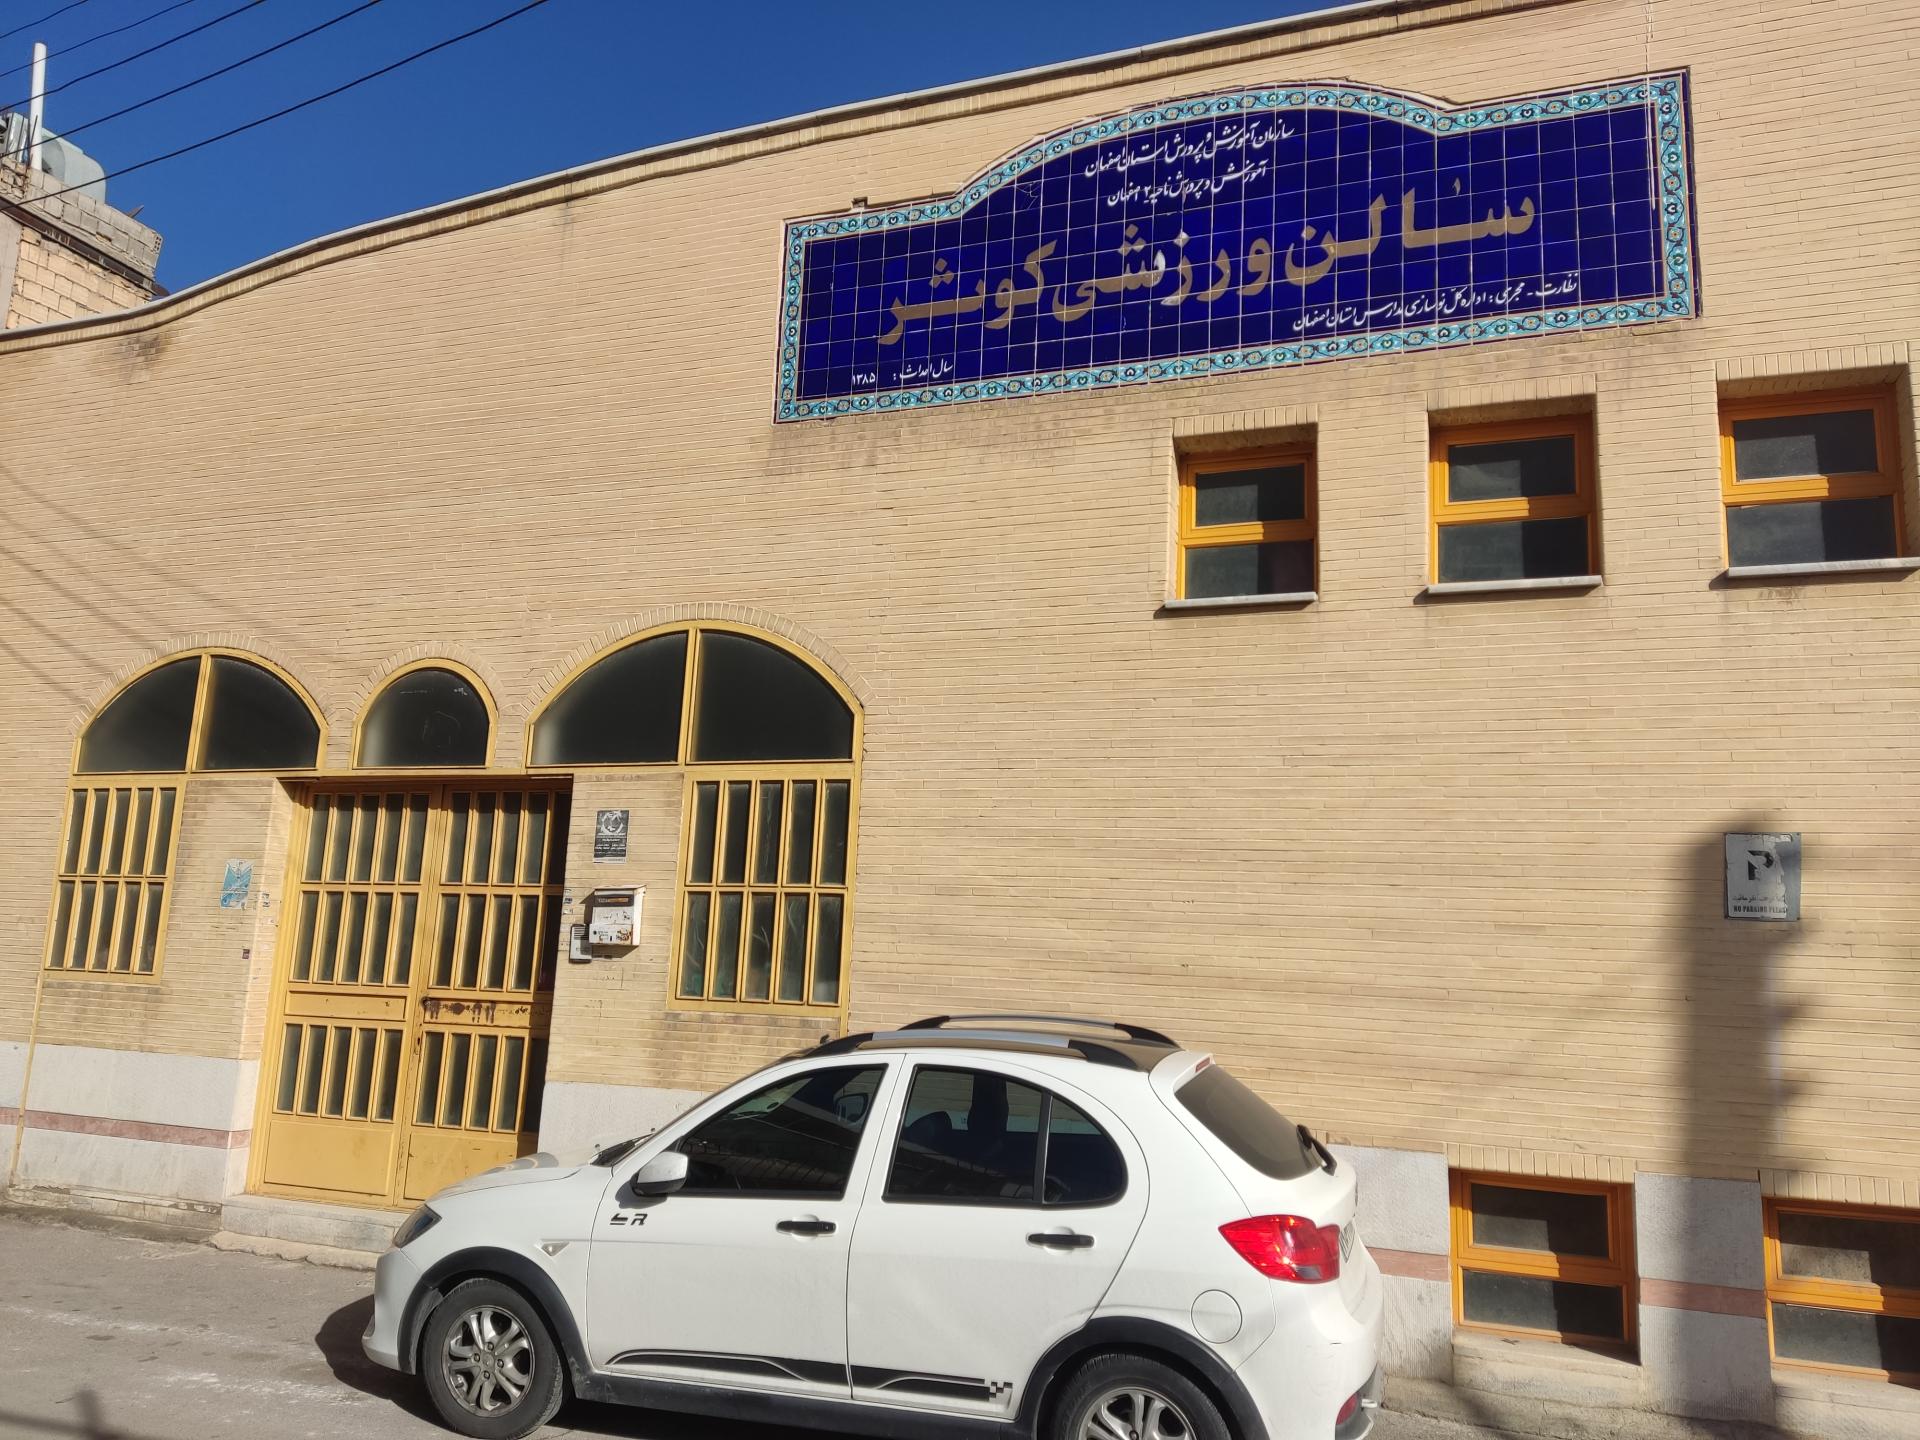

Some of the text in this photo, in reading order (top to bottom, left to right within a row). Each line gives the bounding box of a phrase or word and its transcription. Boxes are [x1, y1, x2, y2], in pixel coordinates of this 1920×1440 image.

[1203, 121, 1260, 159] آموزش
[1252, 119, 1295, 148] سازمان
[1117, 140, 1168, 171] استان
[1165, 133, 1204, 164] پرورش
[1084, 146, 1125, 177] اصفهان
[1169, 170, 1204, 200] پرورش
[1211, 159, 1269, 192] آموزش
[1107, 181, 1141, 206] اصفهان
[878, 178, 1535, 345] سالن ورزشی کوثر
[1535, 272, 1579, 297] نظارت
[1404, 292, 1446, 317] نوسازی
[1460, 291, 1486, 307] اداره
[1292, 308, 1330, 331] اصفهان
[1325, 307, 1357, 327] استان
[1353, 300, 1402, 326] مدارس
[852, 372, 876, 385] ۱۳۸۵
[899, 362, 933, 379] احداث
[932, 358, 953, 378] سال
[1733, 905, 1742, 913] NO
[1743, 905, 1767, 913] PARKING
